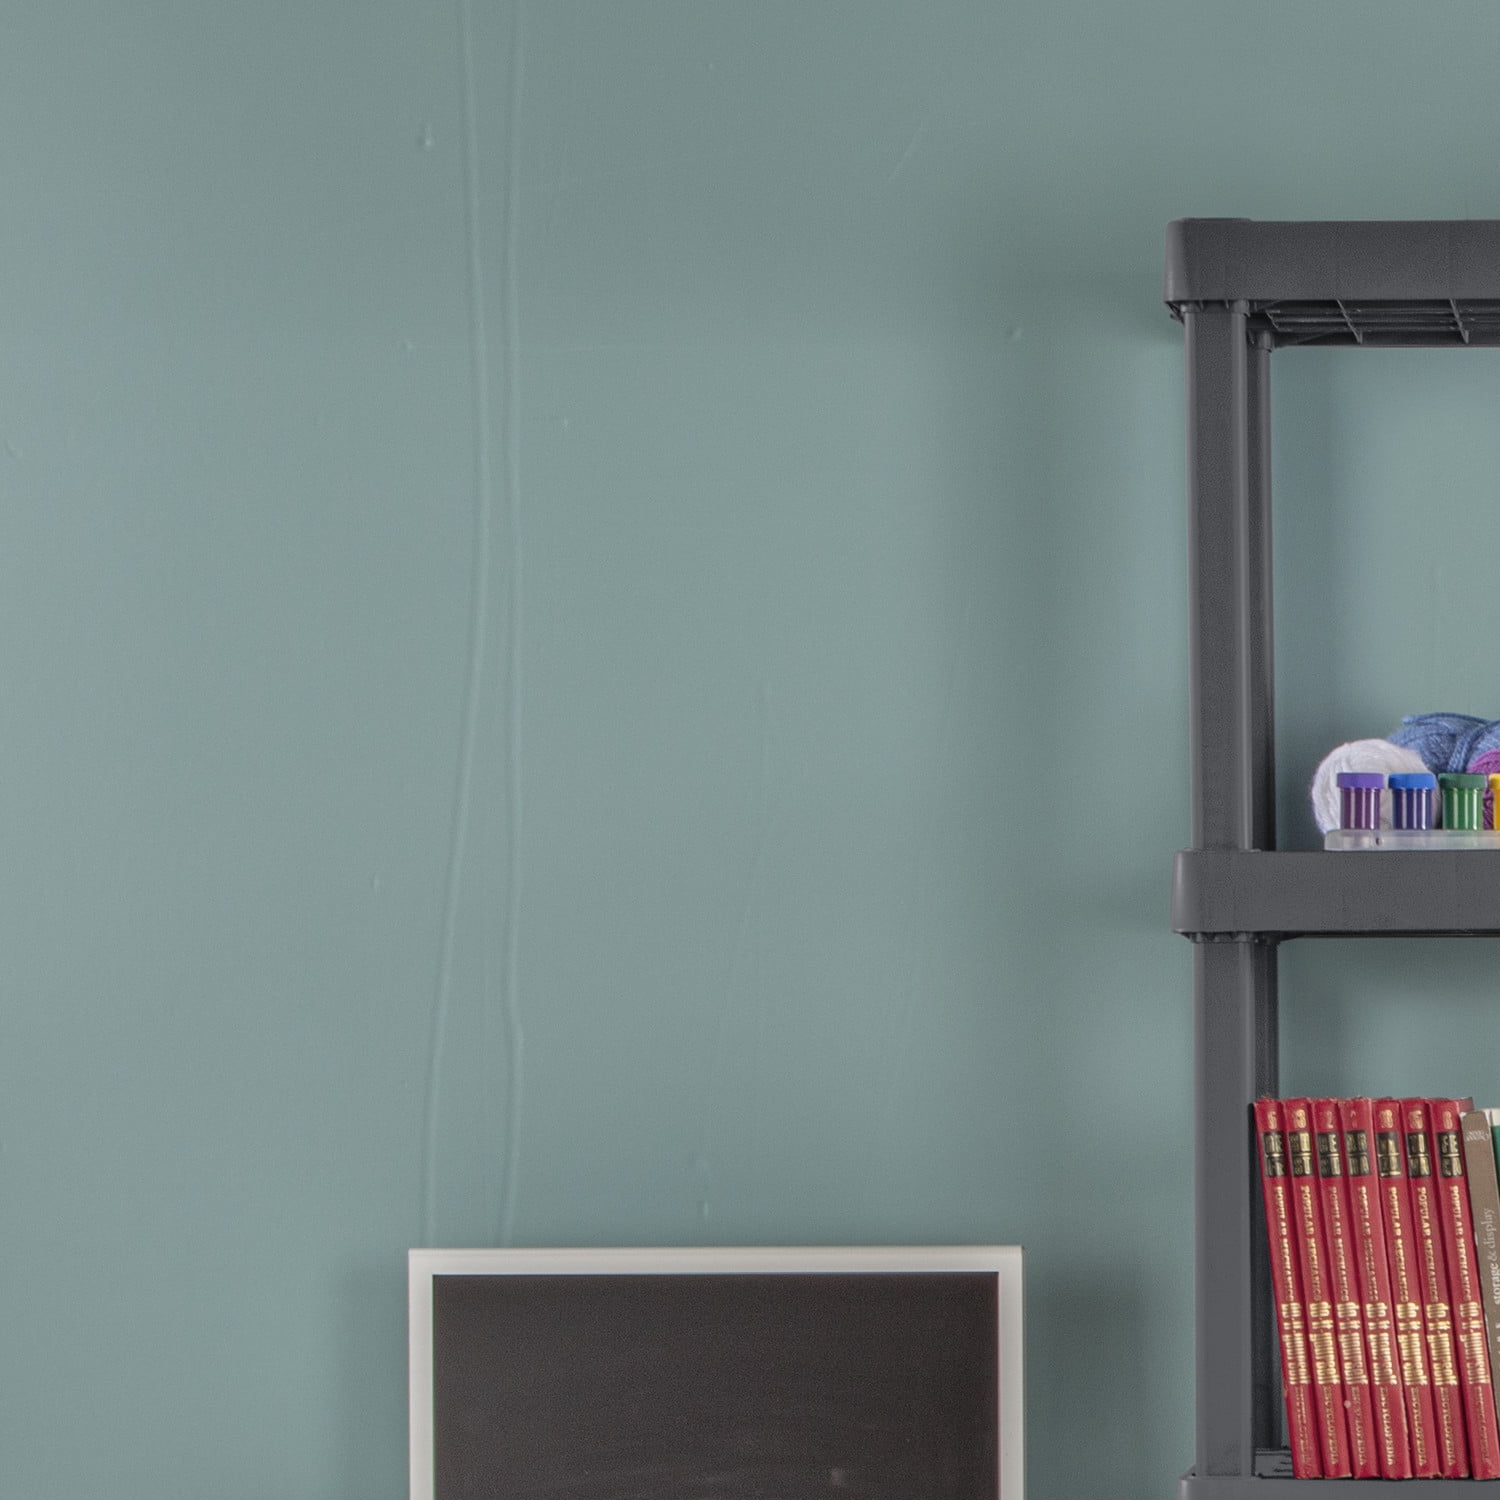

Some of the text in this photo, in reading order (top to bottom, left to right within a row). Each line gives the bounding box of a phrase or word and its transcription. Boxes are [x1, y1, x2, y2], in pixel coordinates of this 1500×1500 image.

[1301, 1185, 1314, 1236] POPULAR
[1358, 1185, 1371, 1236] POPULAR
[1450, 1185, 1464, 1236] POPULAR
[1480, 1207, 1498, 1250] display
[1275, 1185, 1287, 1236] POPULAR
[1281, 1238, 1294, 1301] MECHANICS
[1307, 1238, 1321, 1301] MECHANICS
[1364, 1238, 1379, 1301] MECHANICS
[1456, 1238, 1471, 1301] MECHANICS
[1487, 1251, 1498, 1262] &
[1329, 1185, 1342, 1236] POPULAR
[1336, 1238, 1350, 1301] MECHANICS
[1352, 1386, 1366, 1466] ENCYCLOPEDIA
[1388, 1185, 1401, 1236] POPULAR
[1395, 1238, 1409, 1301] MECHANICS
[1410, 1386, 1427, 1466] ENCYCLOPEDIA
[1417, 1185, 1431, 1236] POPULAR
[1424, 1238, 1439, 1301] MECHANICS
[1440, 1386, 1456, 1466] ENCYCLOPEDIA
[1322, 1386, 1338, 1466] ENCYCLOPEDIA
[1380, 1386, 1395, 1466] ENCYCLOPEDIA
